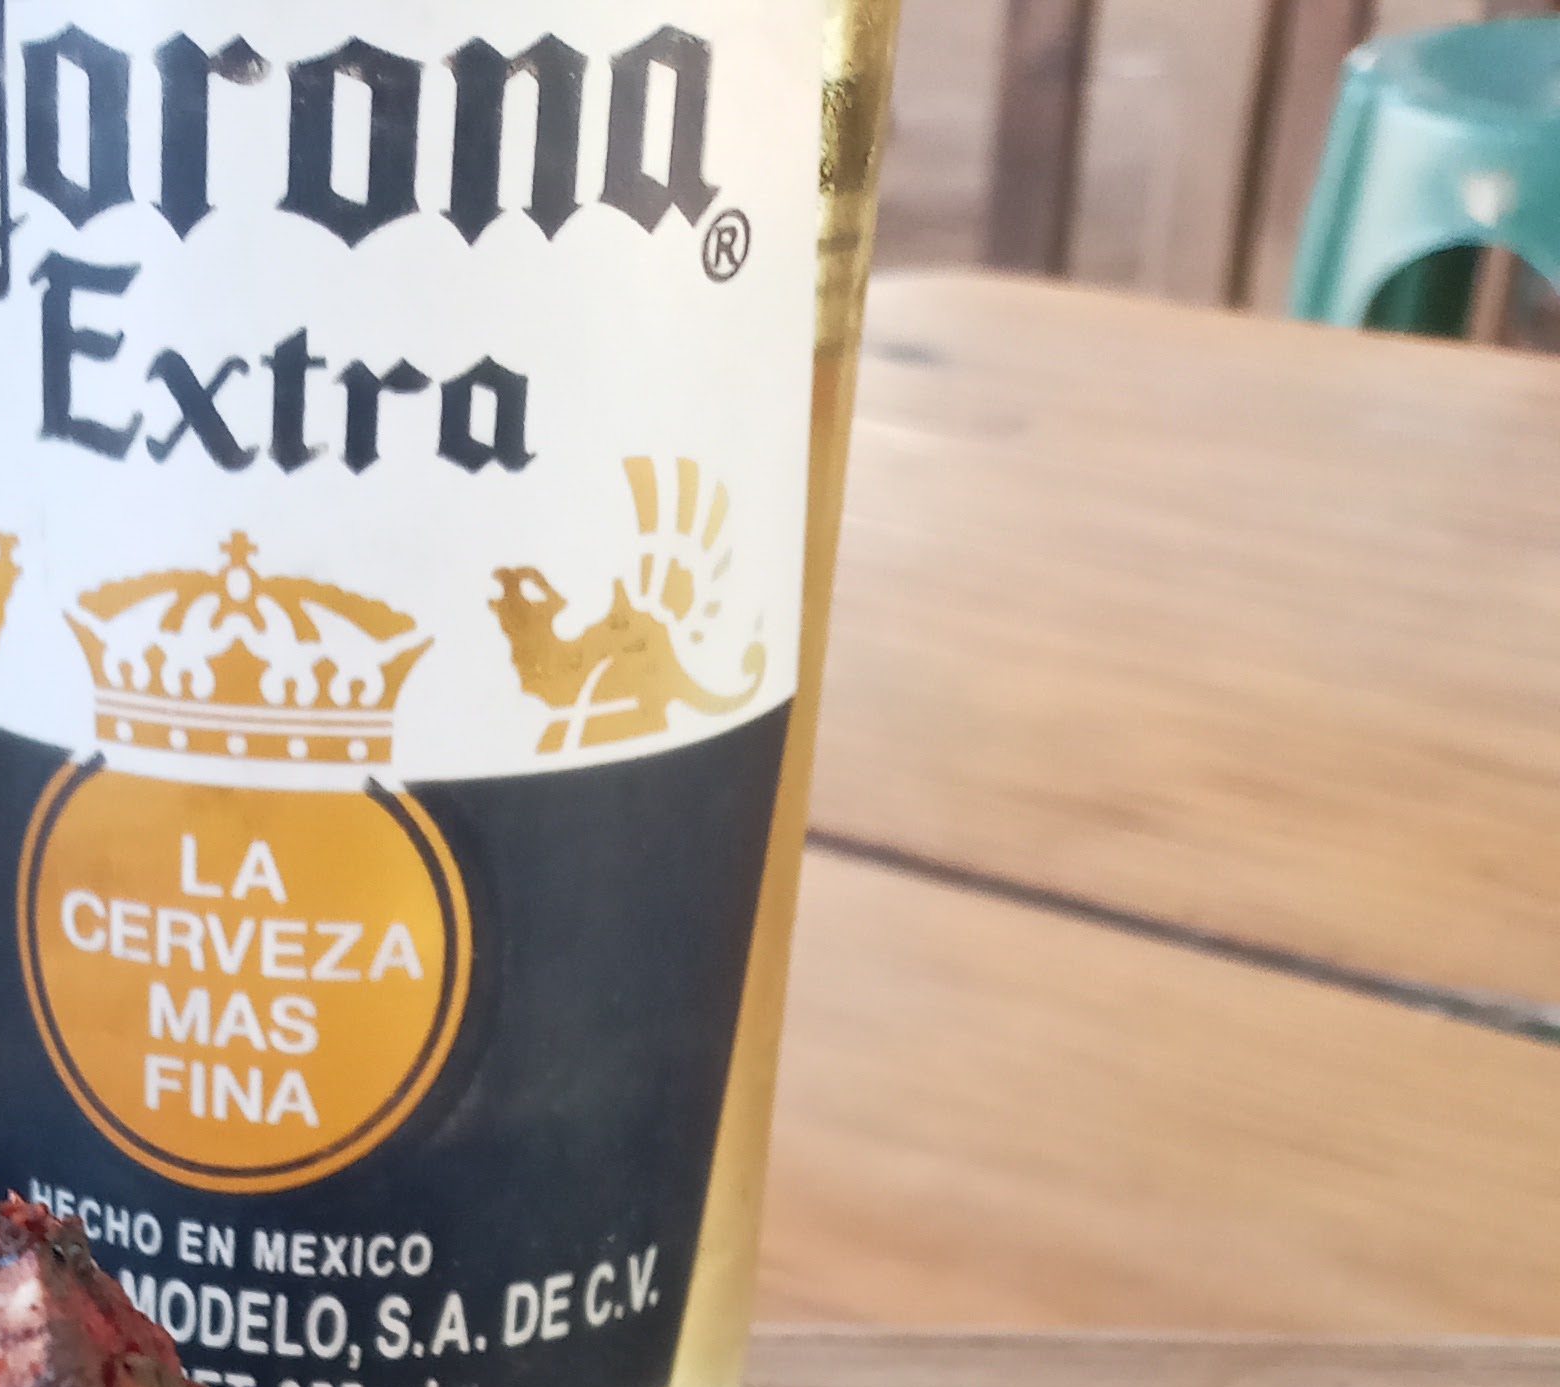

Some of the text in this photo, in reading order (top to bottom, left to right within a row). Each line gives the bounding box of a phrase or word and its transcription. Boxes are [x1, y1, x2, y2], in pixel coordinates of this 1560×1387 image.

[29, 250, 536, 475] Extra
[180, 834, 287, 903] LA
[60, 890, 424, 982] CERVEZA
[148, 984, 319, 1055] MAS
[145, 1055, 319, 1128] FINA
[177, 1218, 236, 1268] EN
[252, 1227, 434, 1278] MEXICO
[118, 1243, 660, 1370] MODELO, S.A. DE C.V.
